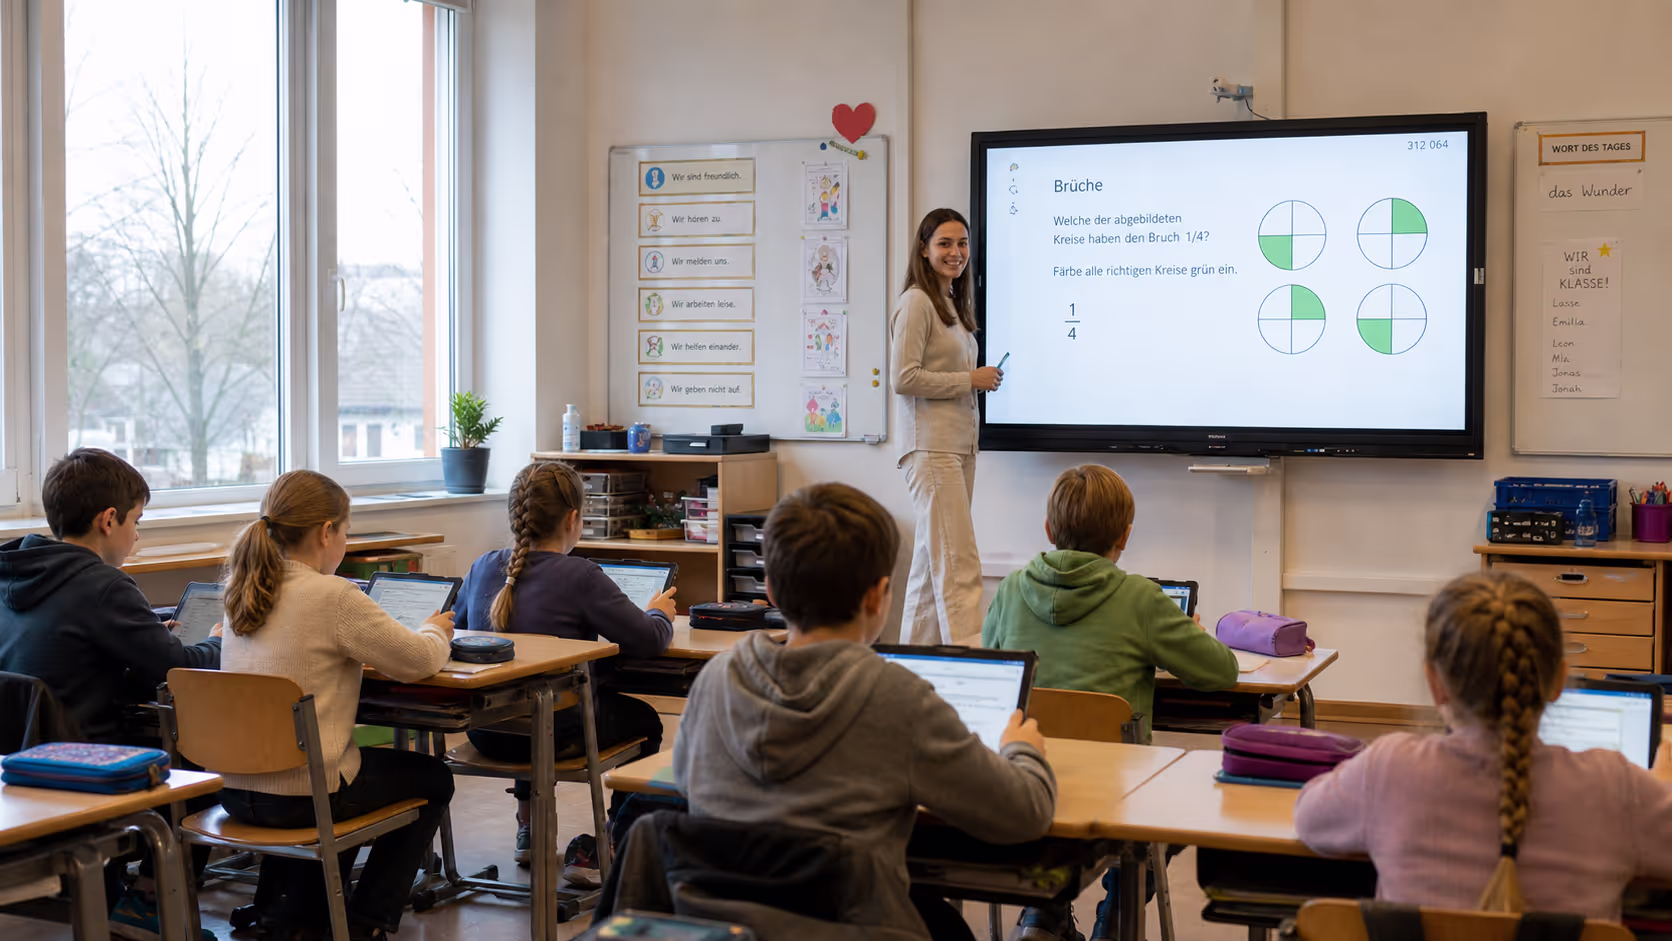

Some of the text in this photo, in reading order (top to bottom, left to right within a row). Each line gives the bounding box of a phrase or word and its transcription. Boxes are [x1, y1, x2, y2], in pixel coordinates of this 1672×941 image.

[1407, 139, 1449, 150] 312 064
[1551, 142, 1632, 153] WORT DES TAGES
[671, 171, 743, 182] Wir sind freundlich.
[1054, 178, 1103, 193] Brüche
[1548, 183, 1633, 199] das Wunder
[671, 215, 685, 224] Wir
[1053, 213, 1182, 227] Welche der abgebildeten
[1053, 230, 1210, 245] Kreise haben den Bruch 1/4?
[671, 257, 730, 266] Wir melden uns.
[1563, 250, 1590, 262] WIR
[1053, 263, 1238, 279] Färbe alle richtigen Kreise grün ein.
[1569, 264, 1593, 276] sind
[1559, 276, 1609, 290] KLASSE!
[671, 299, 736, 309] Wir arbeiten leise.
[1552, 298, 1581, 308] Lasse
[1069, 303, 1076, 317] 1
[1067, 326, 1077, 341] 4
[670, 342, 684, 351] Wir
[708, 342, 742, 351] einander.
[1551, 367, 1581, 378] Jonas
[670, 384, 683, 393] Wir
[684, 385, 707, 396] geben
[708, 385, 726, 394] nicht
[1551, 383, 1582, 394] Jonah
